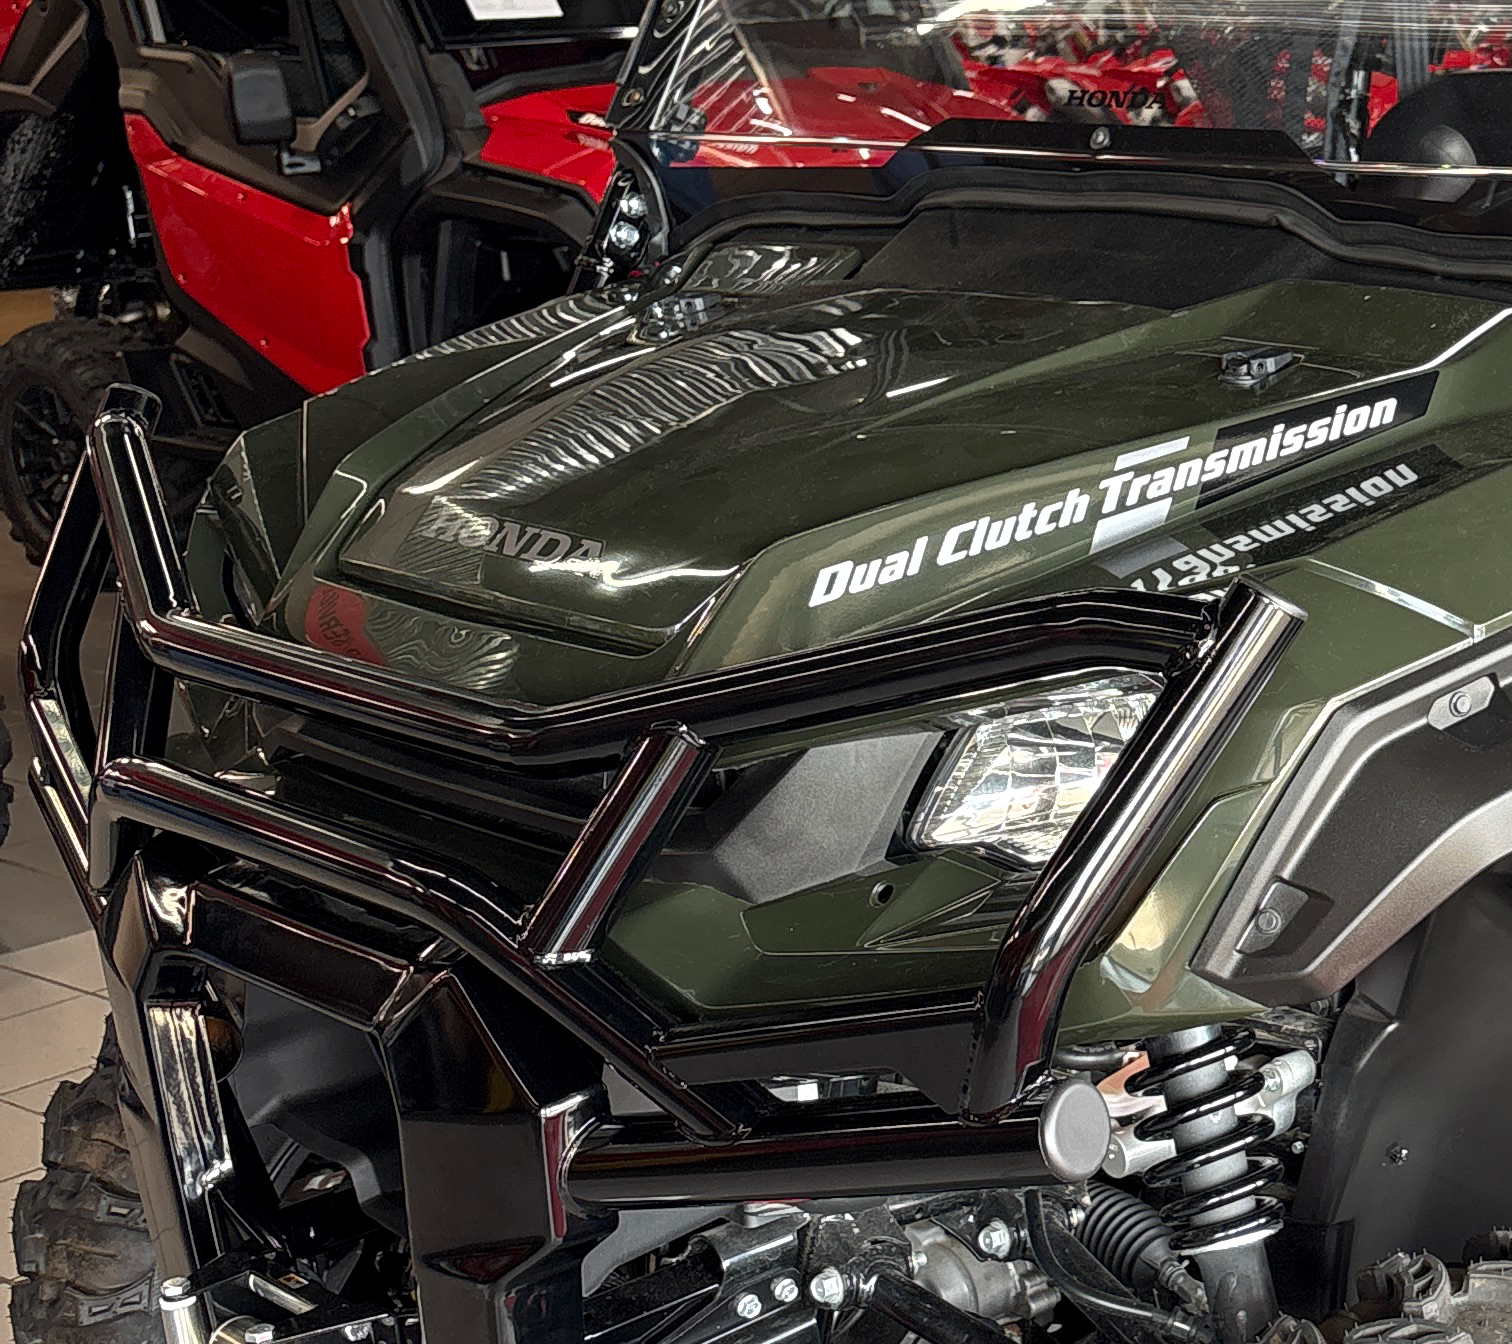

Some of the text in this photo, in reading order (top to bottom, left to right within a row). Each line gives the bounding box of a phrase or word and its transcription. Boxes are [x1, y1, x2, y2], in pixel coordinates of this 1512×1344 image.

[1064, 88, 1167, 110] HONDA
[807, 397, 1399, 609] Dual Clutch Transmission
[420, 512, 603, 564] HONDA
